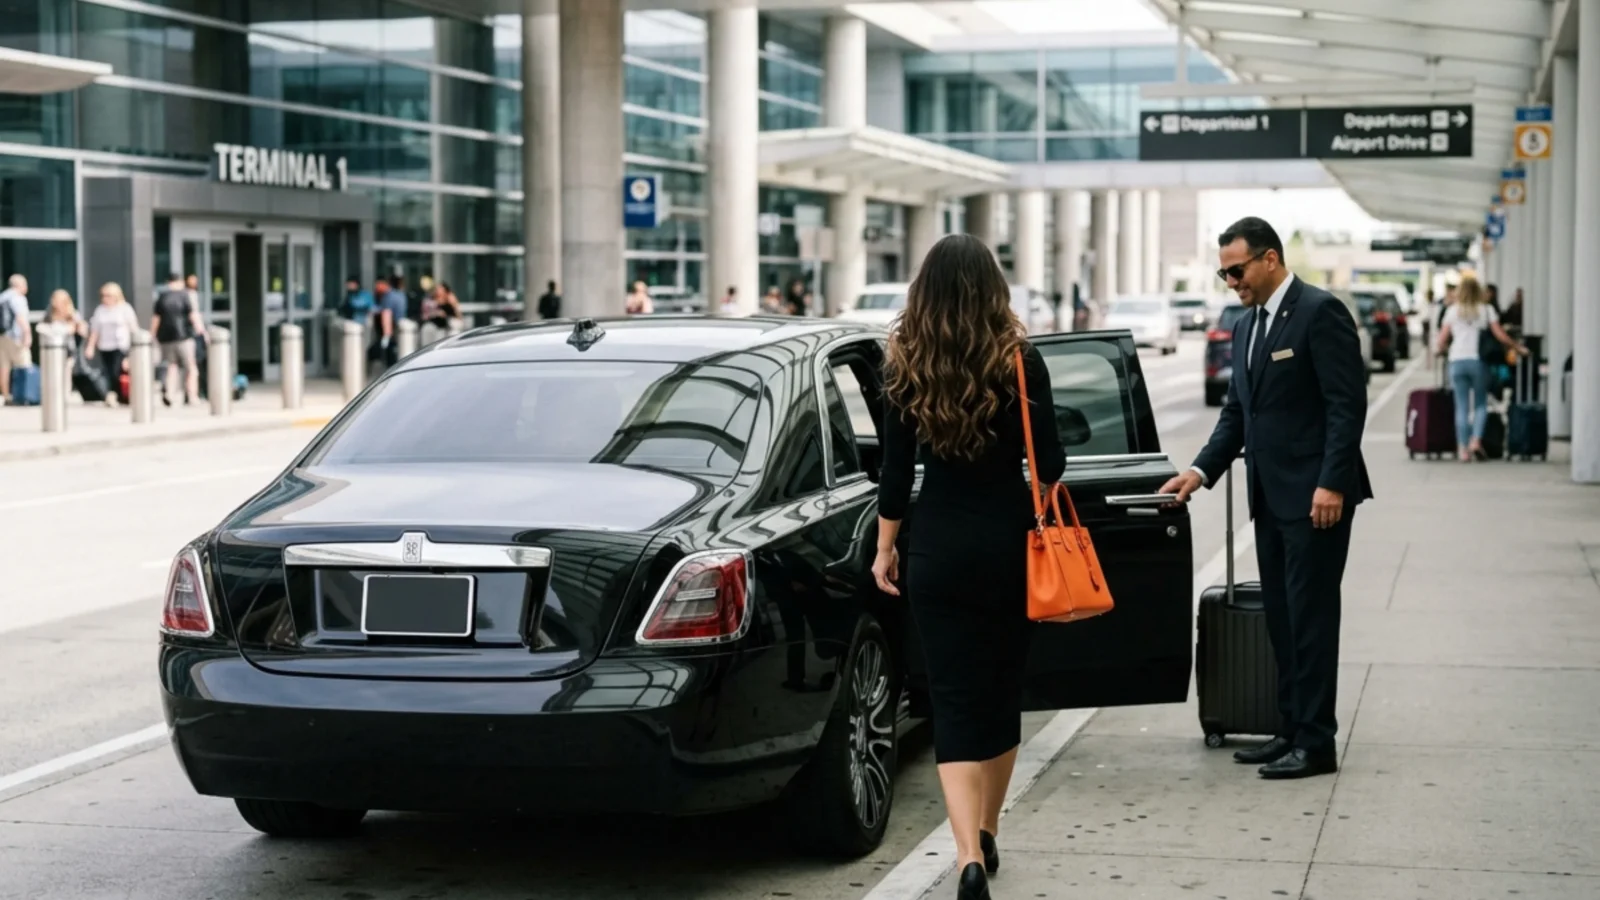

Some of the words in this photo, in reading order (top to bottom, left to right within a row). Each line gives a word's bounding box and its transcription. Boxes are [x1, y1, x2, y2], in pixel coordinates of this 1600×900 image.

[1261, 114, 1269, 130] 1
[1343, 112, 1428, 132] Departures
[1331, 134, 1385, 154] Airport
[1387, 133, 1428, 151] Drive
[213, 142, 333, 191] TERMINAL
[336, 156, 348, 192] 1
